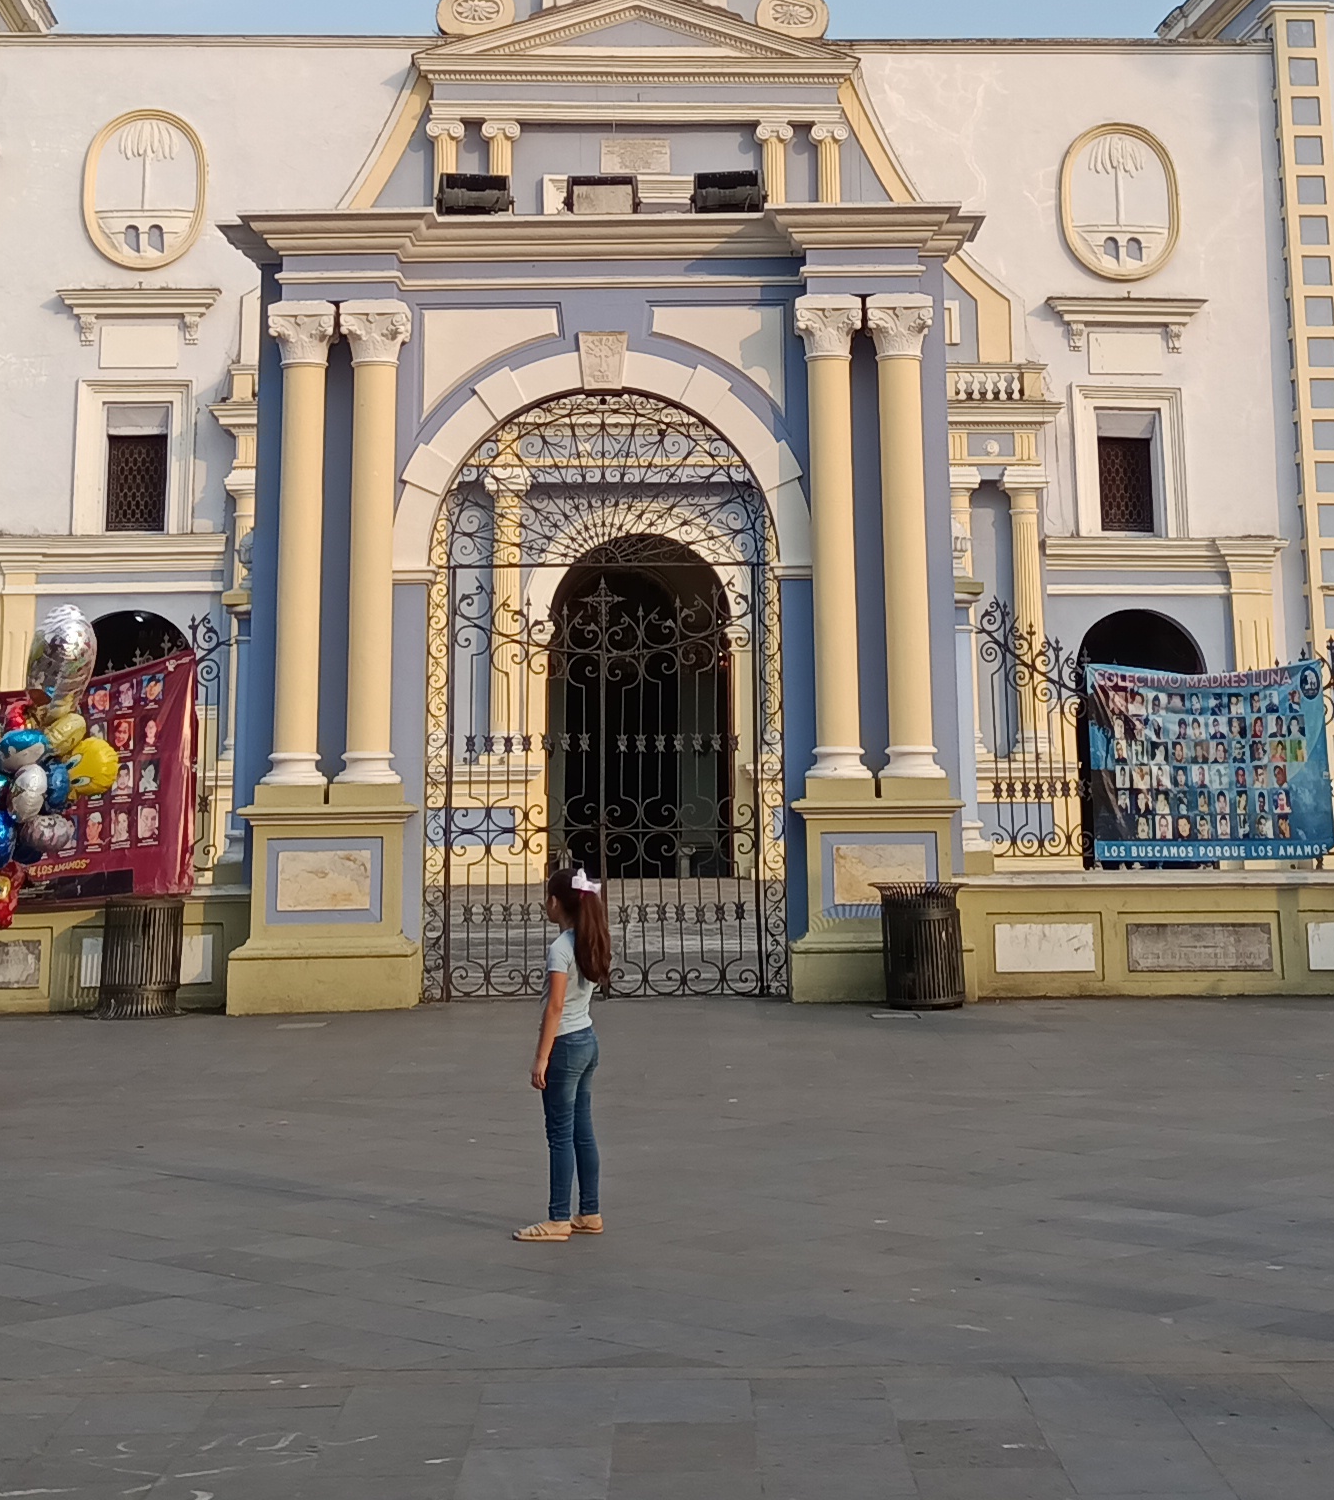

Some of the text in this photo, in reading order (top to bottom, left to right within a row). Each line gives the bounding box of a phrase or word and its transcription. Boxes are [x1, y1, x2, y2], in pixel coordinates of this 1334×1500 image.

[1094, 669, 1292, 689] COLECTIVO MADRES LUNA
[1104, 843, 1329, 858] LOS BUSCAMOS PORQUE LOS AMAMOS
